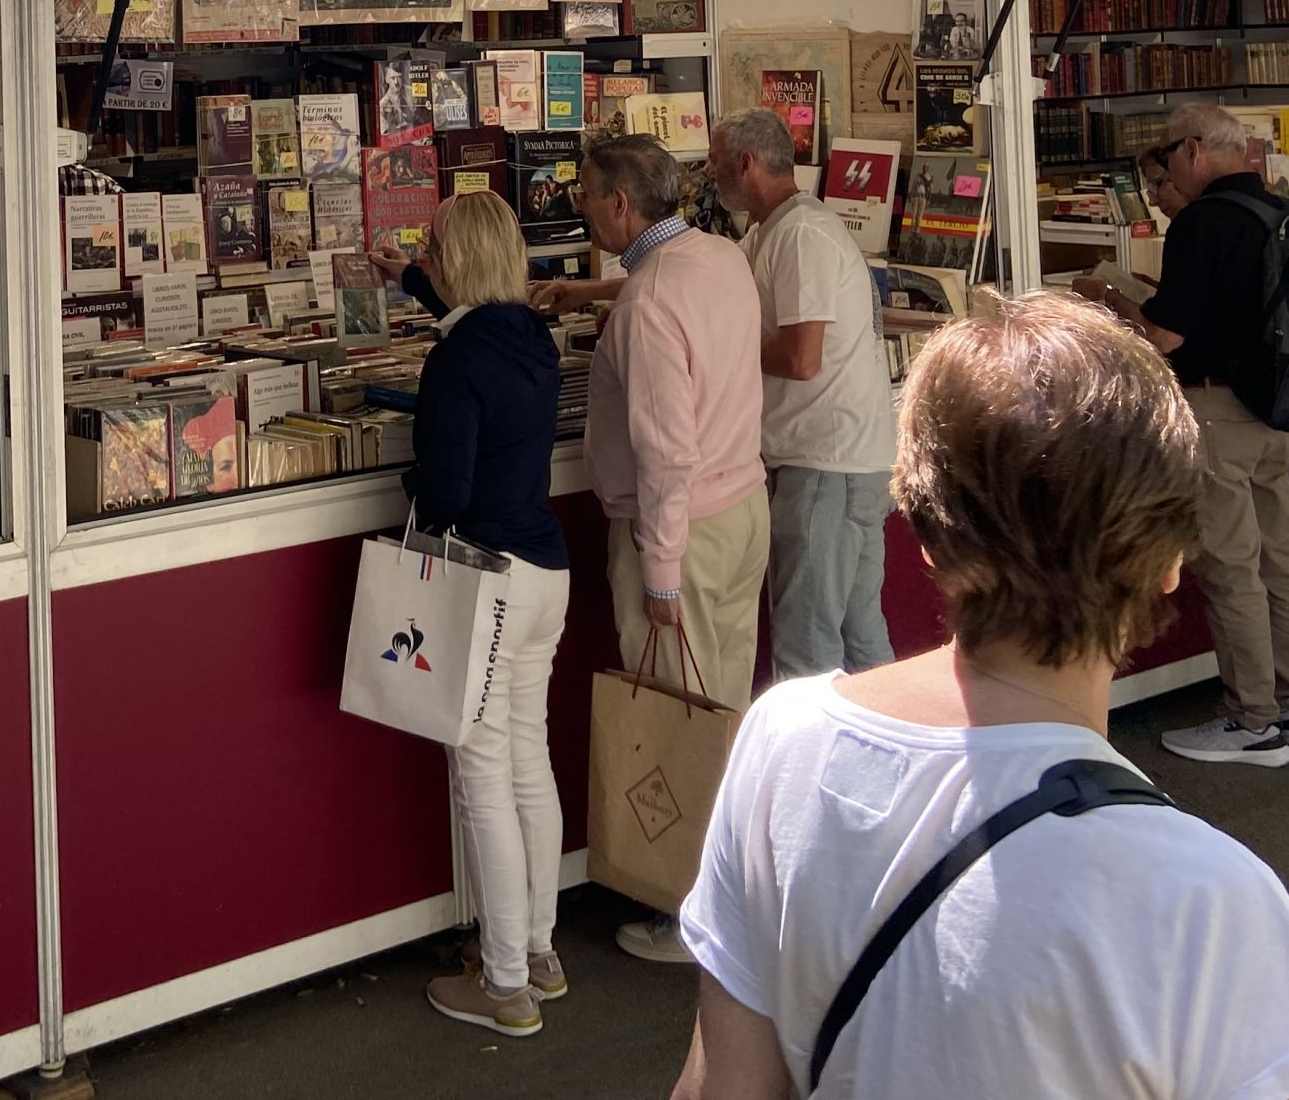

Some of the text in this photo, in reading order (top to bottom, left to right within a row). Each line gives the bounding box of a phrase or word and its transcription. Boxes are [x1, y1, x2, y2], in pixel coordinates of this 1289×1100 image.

[606, 85, 646, 93] POPULAR
[771, 82, 814, 92] ARMADA
[109, 99, 169, 109] PARTIR DE 20 €
[302, 105, 343, 114] Términos
[446, 105, 468, 120] ULISES
[302, 114, 343, 122] biológicos
[661, 115, 670, 140] pincel
[213, 182, 241, 191] Azaña
[70, 205, 102, 213] Narrativas
[70, 213, 106, 221] guerrilleras
[925, 219, 969, 230] EL TERCIO
[61, 301, 128, 316] GUITARRISTAS
[104, 494, 137, 512] Caleb
